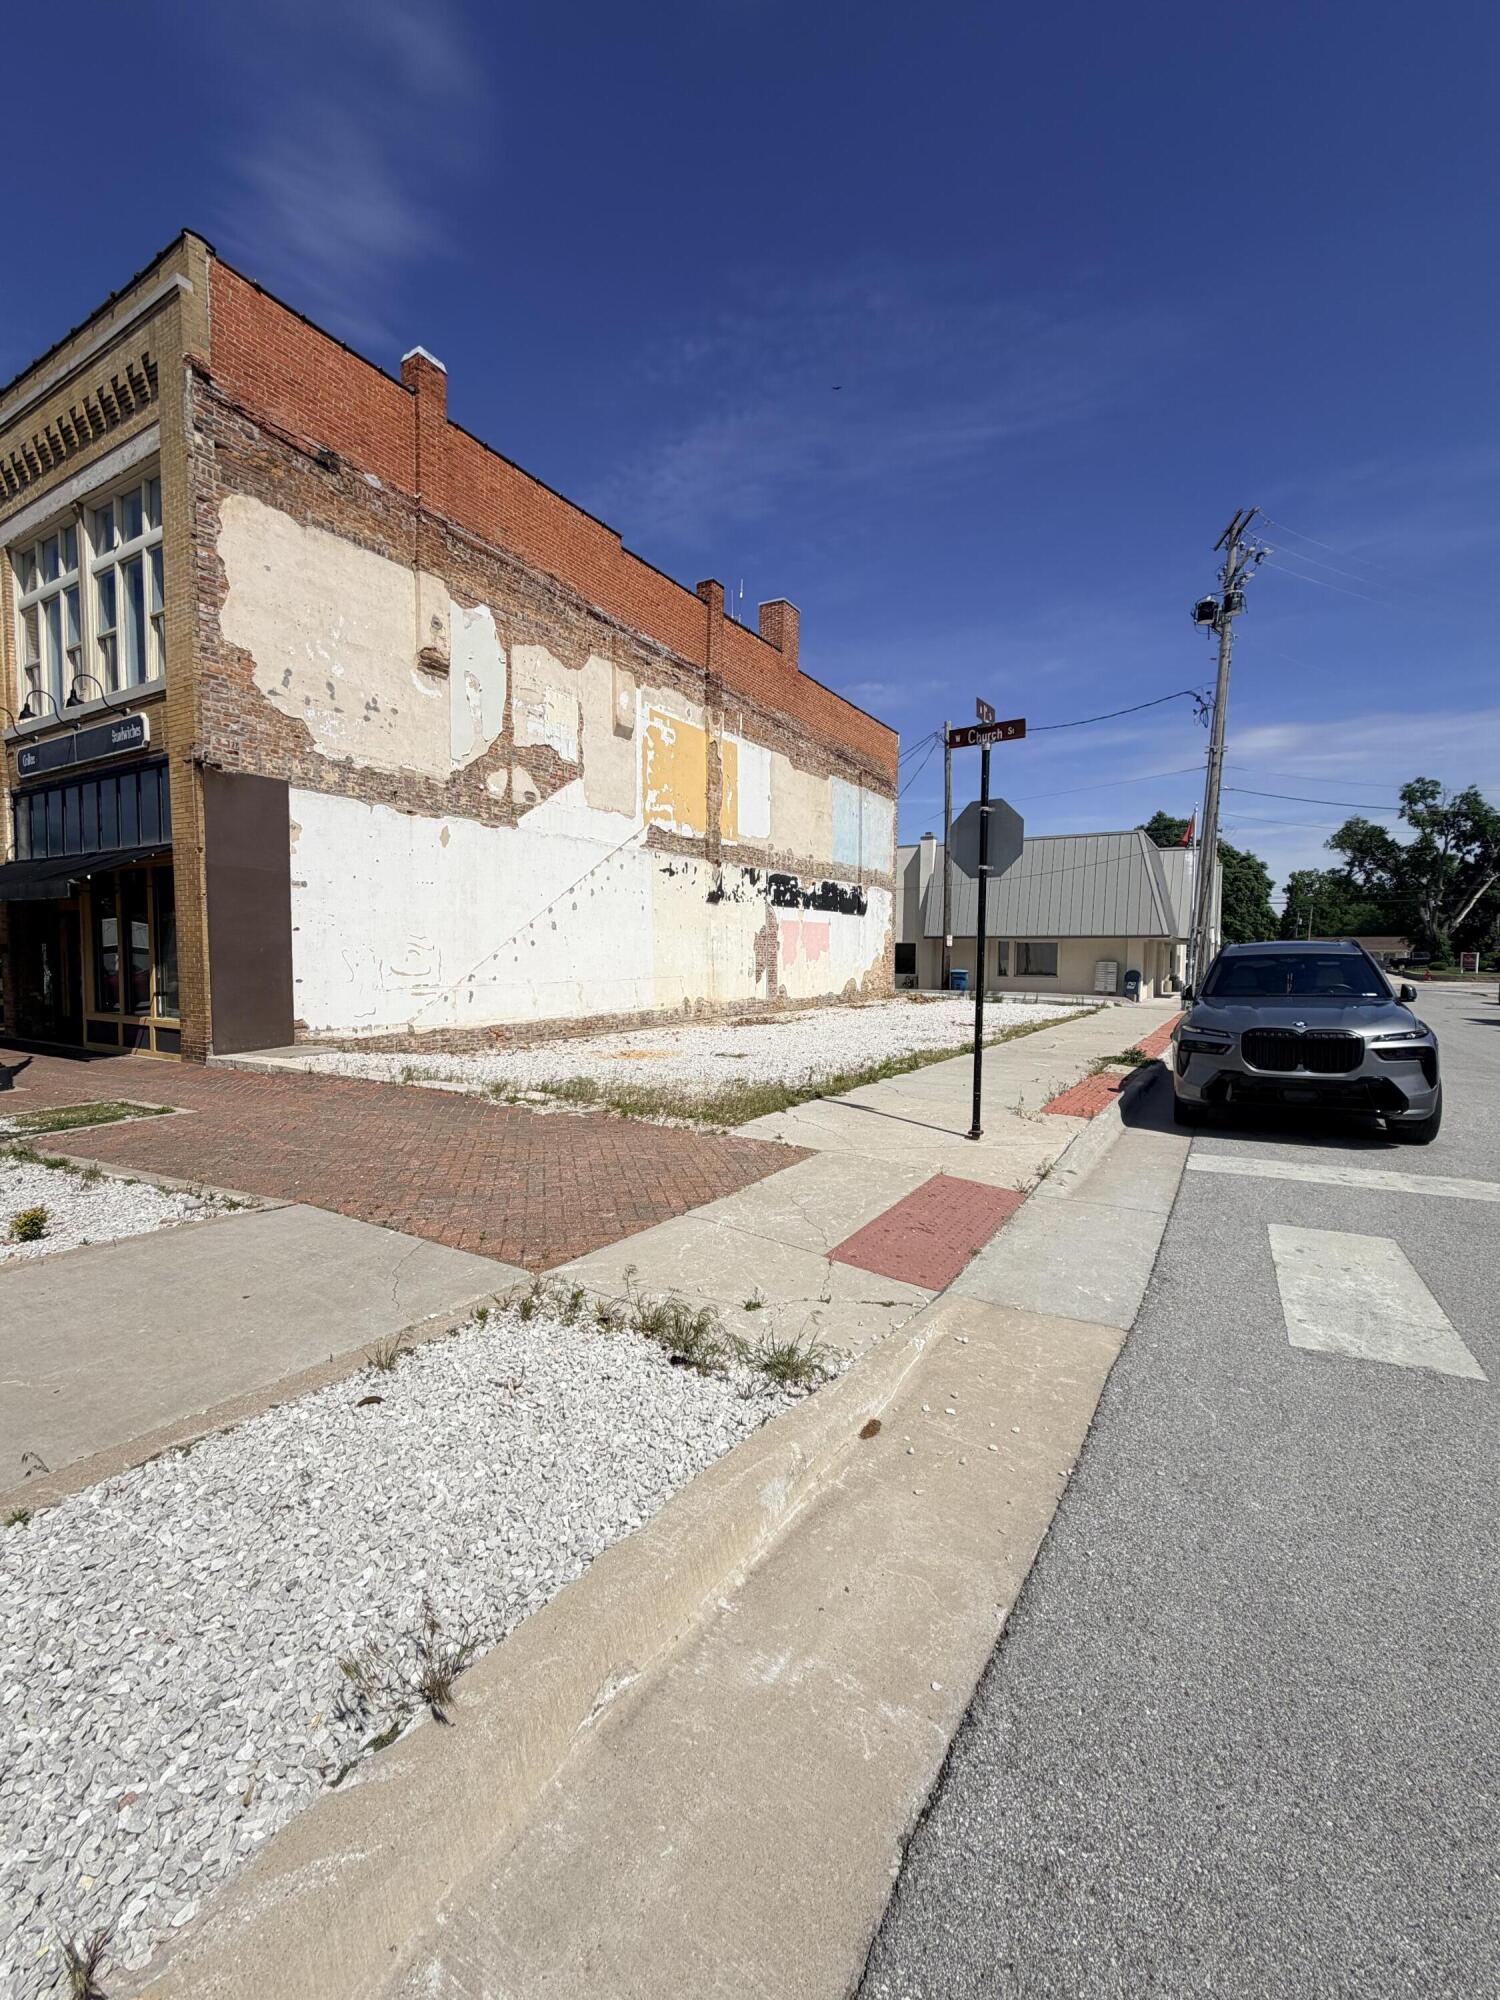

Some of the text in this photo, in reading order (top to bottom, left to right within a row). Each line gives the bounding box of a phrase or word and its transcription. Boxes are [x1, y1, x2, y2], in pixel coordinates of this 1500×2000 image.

[112, 724, 141, 743] Sandwiches
[967, 728, 1003, 744] Church
[1007, 726, 1015, 735] St
